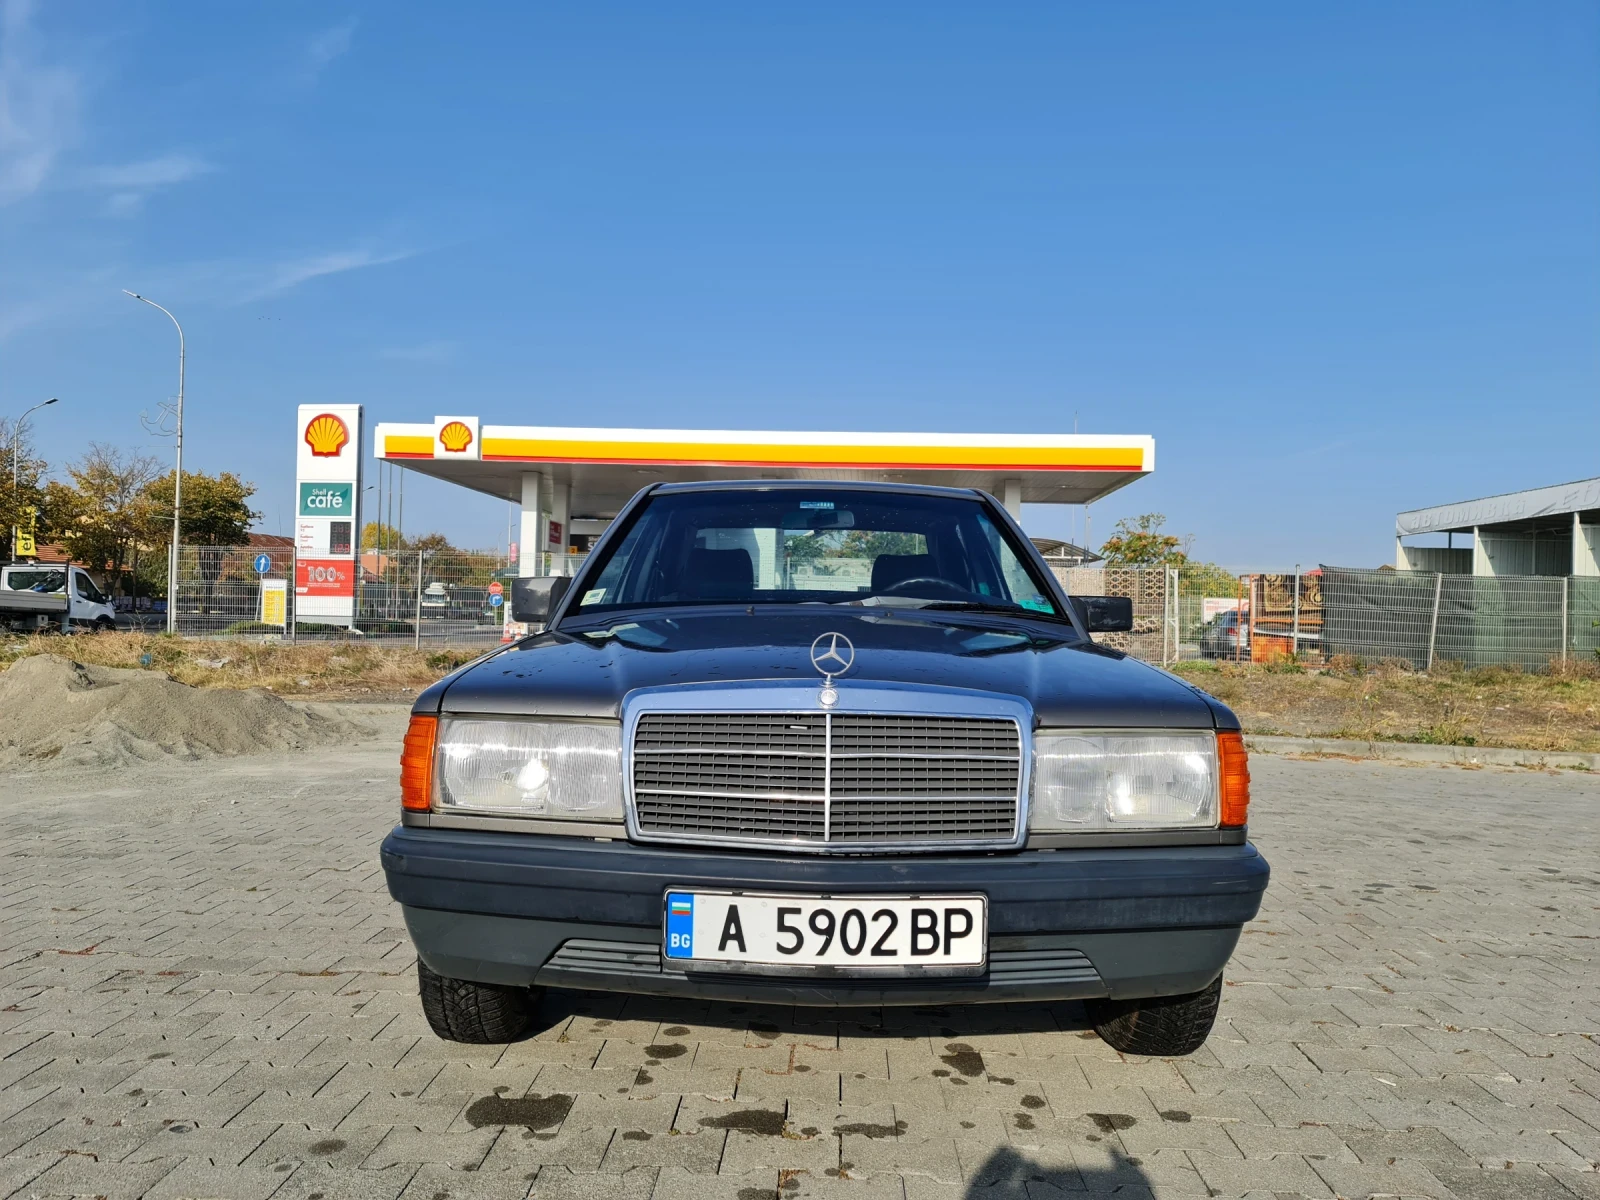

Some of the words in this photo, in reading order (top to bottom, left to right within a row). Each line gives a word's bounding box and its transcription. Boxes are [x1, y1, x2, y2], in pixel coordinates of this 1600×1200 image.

[307, 490, 343, 508] café
[312, 488, 327, 496] Shell
[718, 904, 747, 953] A
[776, 907, 899, 957] 5902
[910, 908, 974, 957] BP
[671, 933, 691, 948] BG
